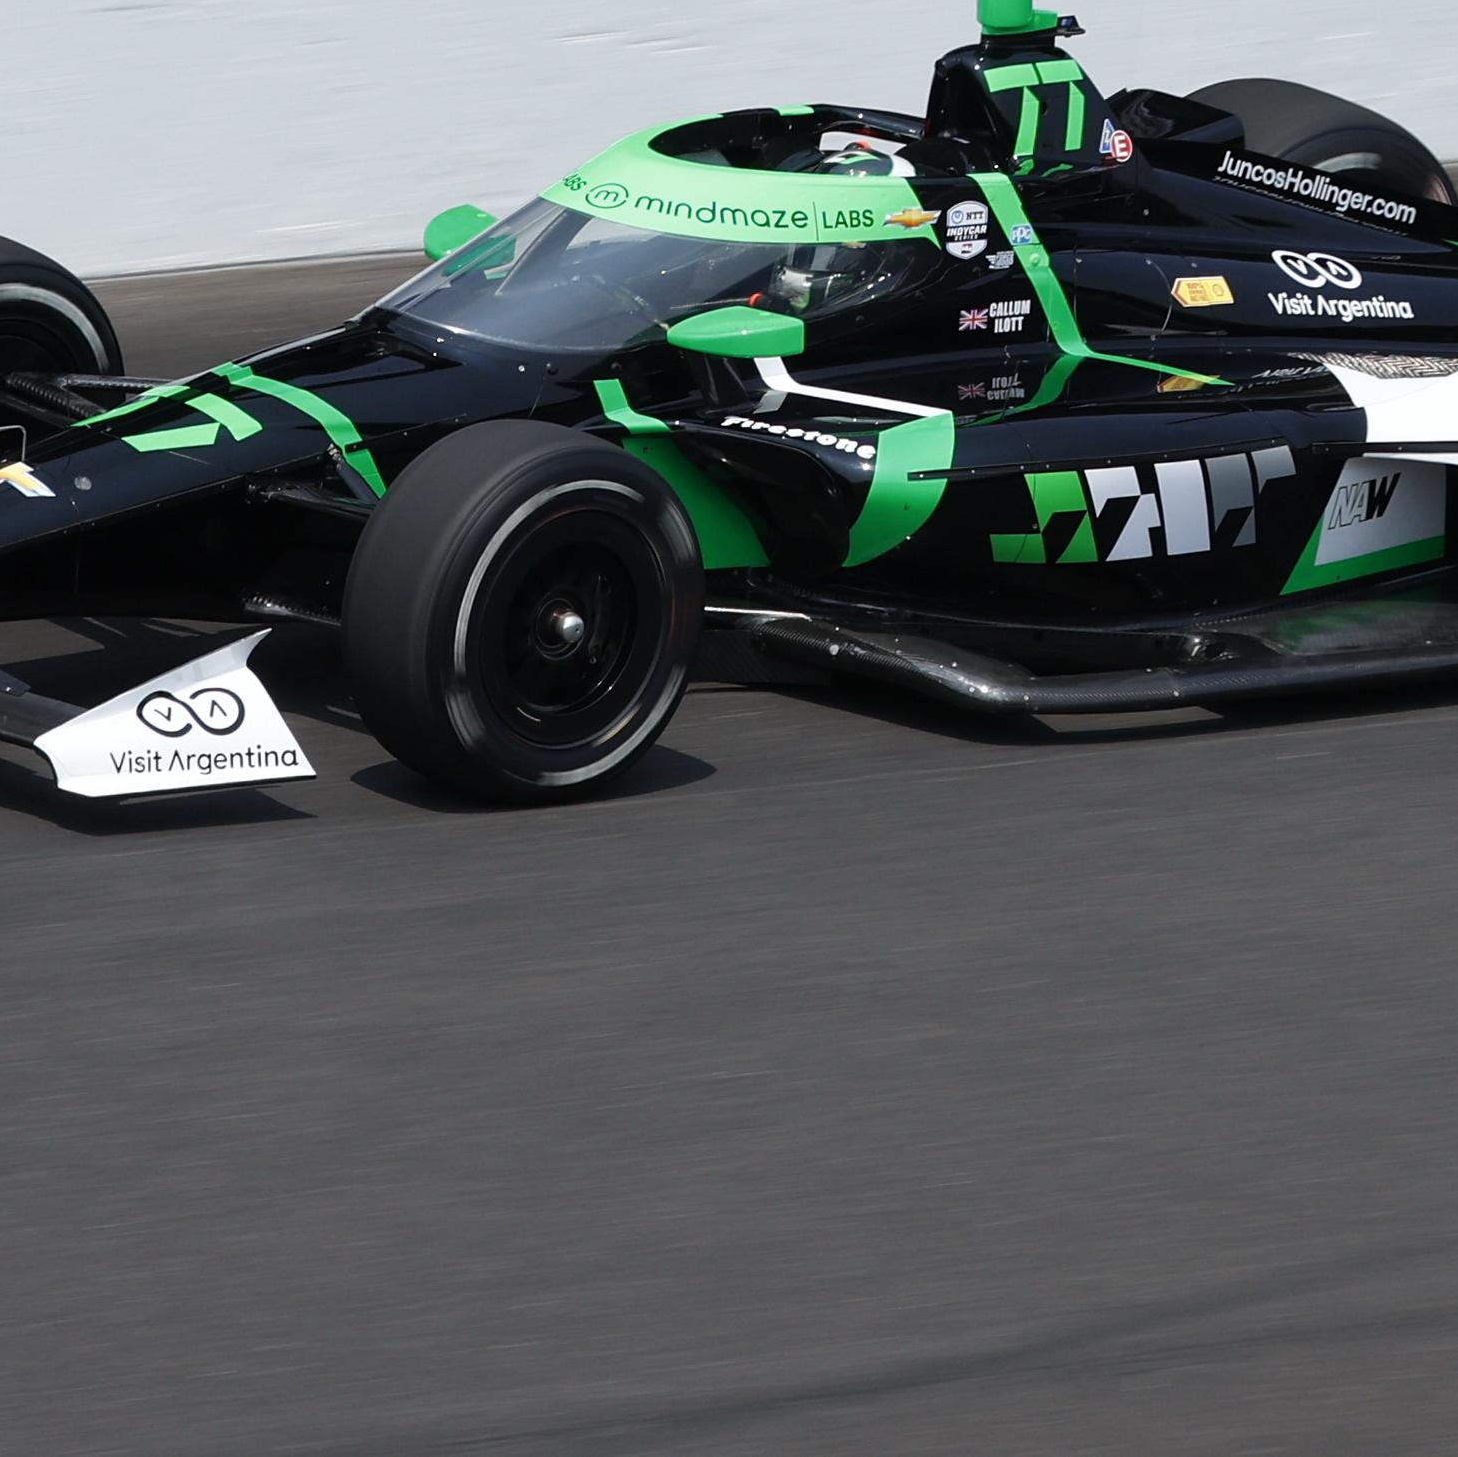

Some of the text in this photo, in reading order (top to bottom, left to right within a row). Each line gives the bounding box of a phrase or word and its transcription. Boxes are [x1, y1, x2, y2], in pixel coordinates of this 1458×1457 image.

[1217, 150, 1417, 224] JuncosHollinger.com
[635, 195, 874, 229] mindmaze LABS
[966, 210, 984, 220] NTT
[946, 225, 987, 237] INDYCAR
[989, 299, 1031, 317] CALLUM
[1267, 292, 1414, 322] Visit Argentina
[994, 316, 1024, 333] ILOTT
[720, 416, 876, 459] Firestone
[110, 745, 299, 775] Visit Argentina
